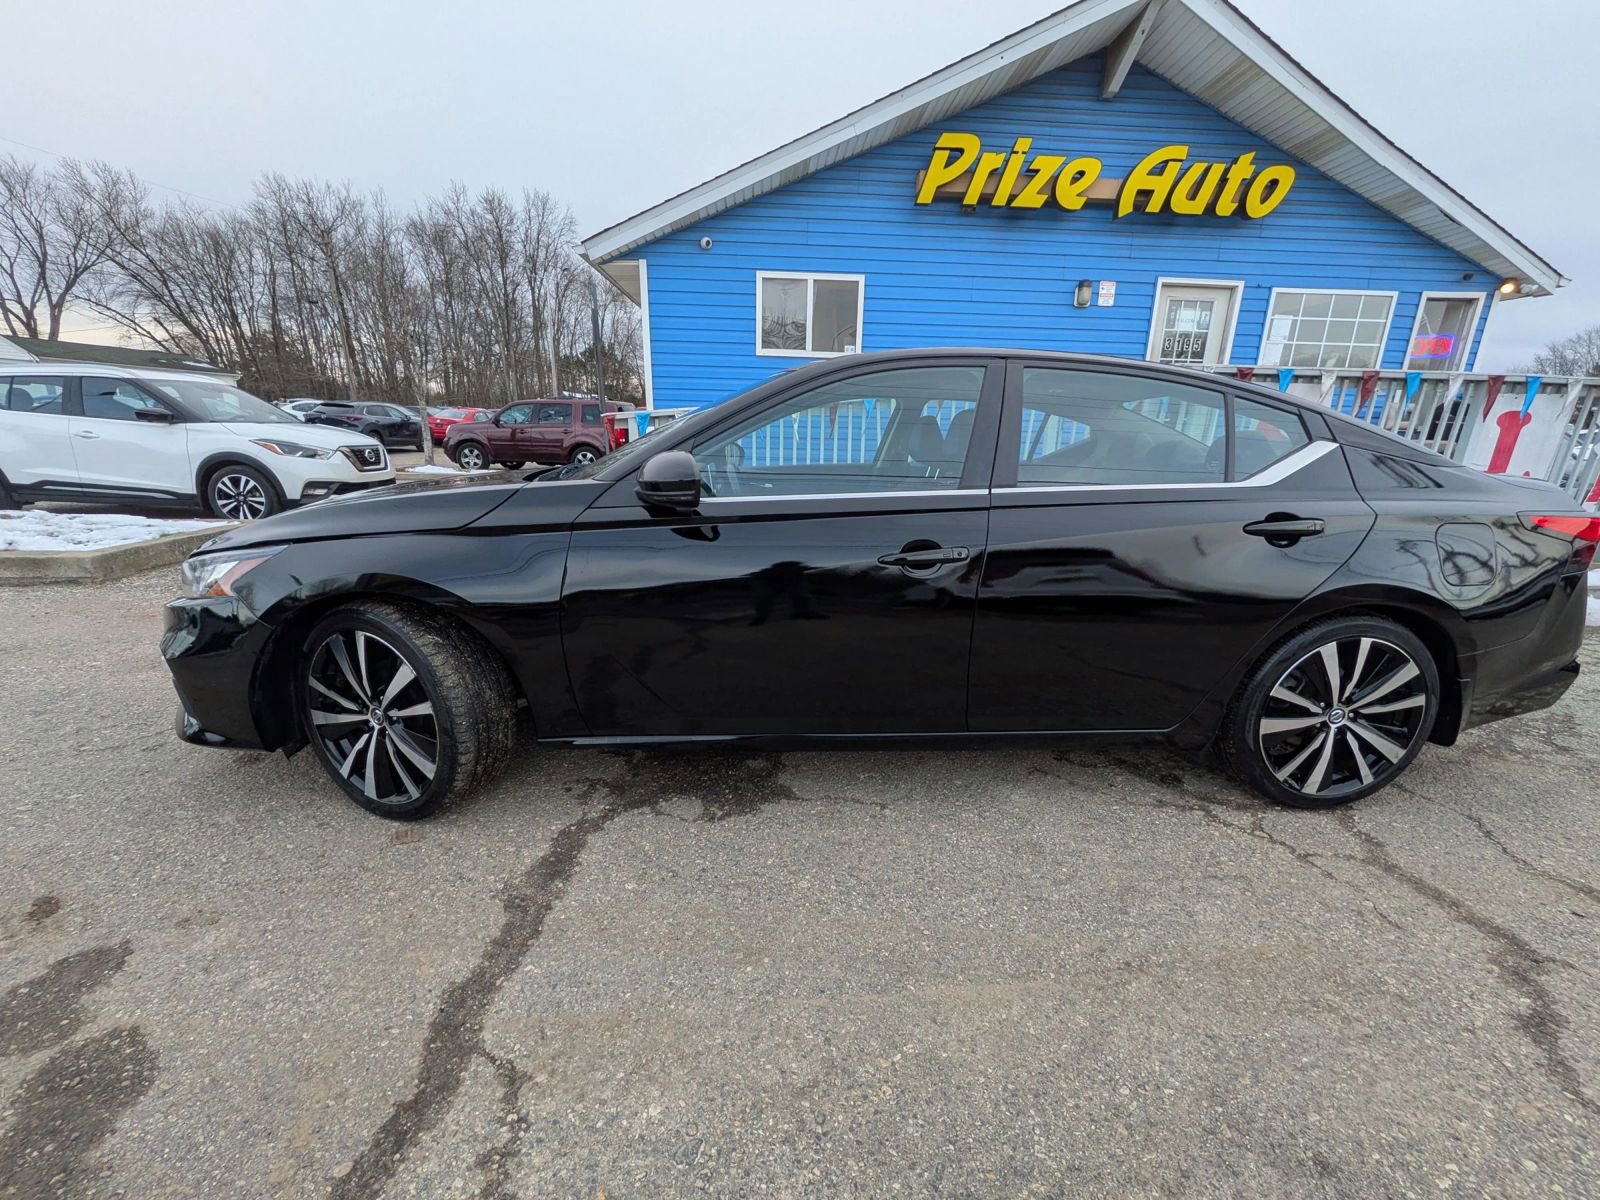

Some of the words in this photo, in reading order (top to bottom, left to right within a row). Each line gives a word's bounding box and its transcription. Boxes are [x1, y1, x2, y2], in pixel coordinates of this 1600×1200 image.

[915, 132, 1102, 210] Prize
[1117, 145, 1296, 219] Auto
[1165, 338, 1201, 350] 3195
